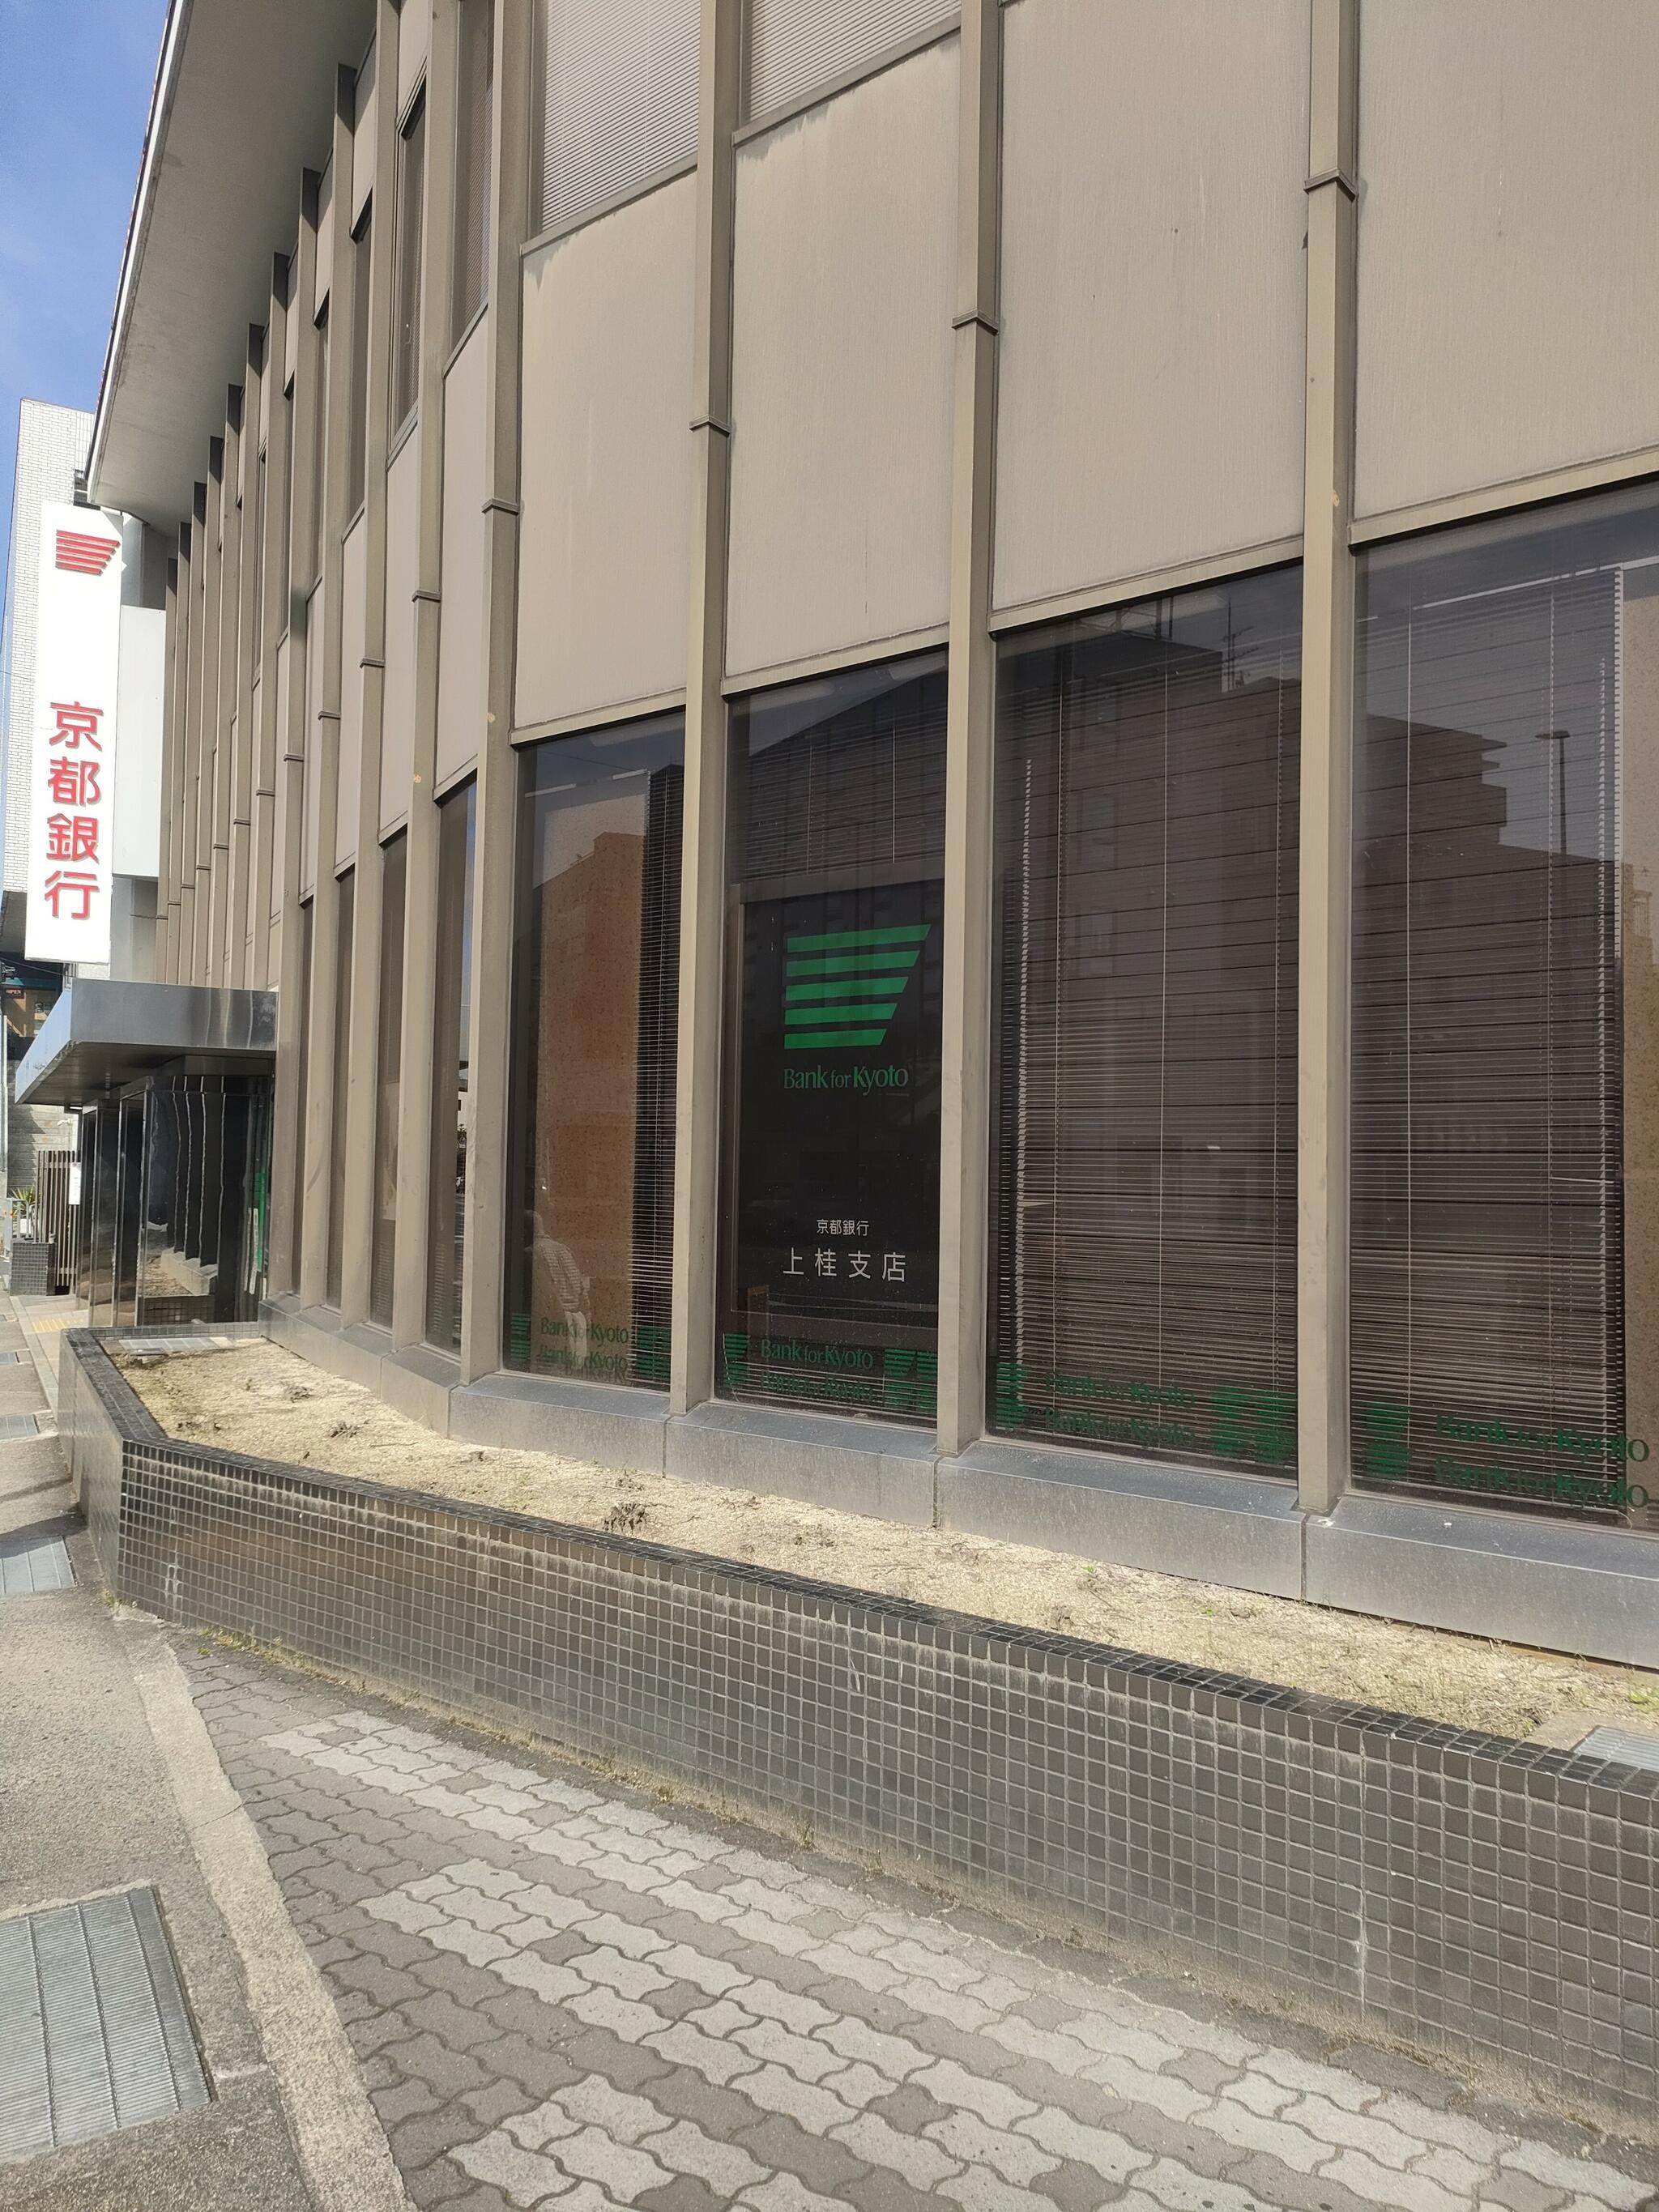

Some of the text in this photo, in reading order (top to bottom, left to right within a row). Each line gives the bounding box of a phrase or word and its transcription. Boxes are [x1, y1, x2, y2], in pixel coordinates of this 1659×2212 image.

[45, 701, 104, 919] 京都銀行
[783, 1064, 909, 1095] Bank for Kyoto
[817, 1218, 869, 1237] 京都銀行
[783, 1247, 906, 1282] 上桂支店
[540, 1316, 570, 1336] Bank
[590, 1323, 629, 1347] Kyoto
[761, 1339, 873, 1371] Bank for Kyoto
